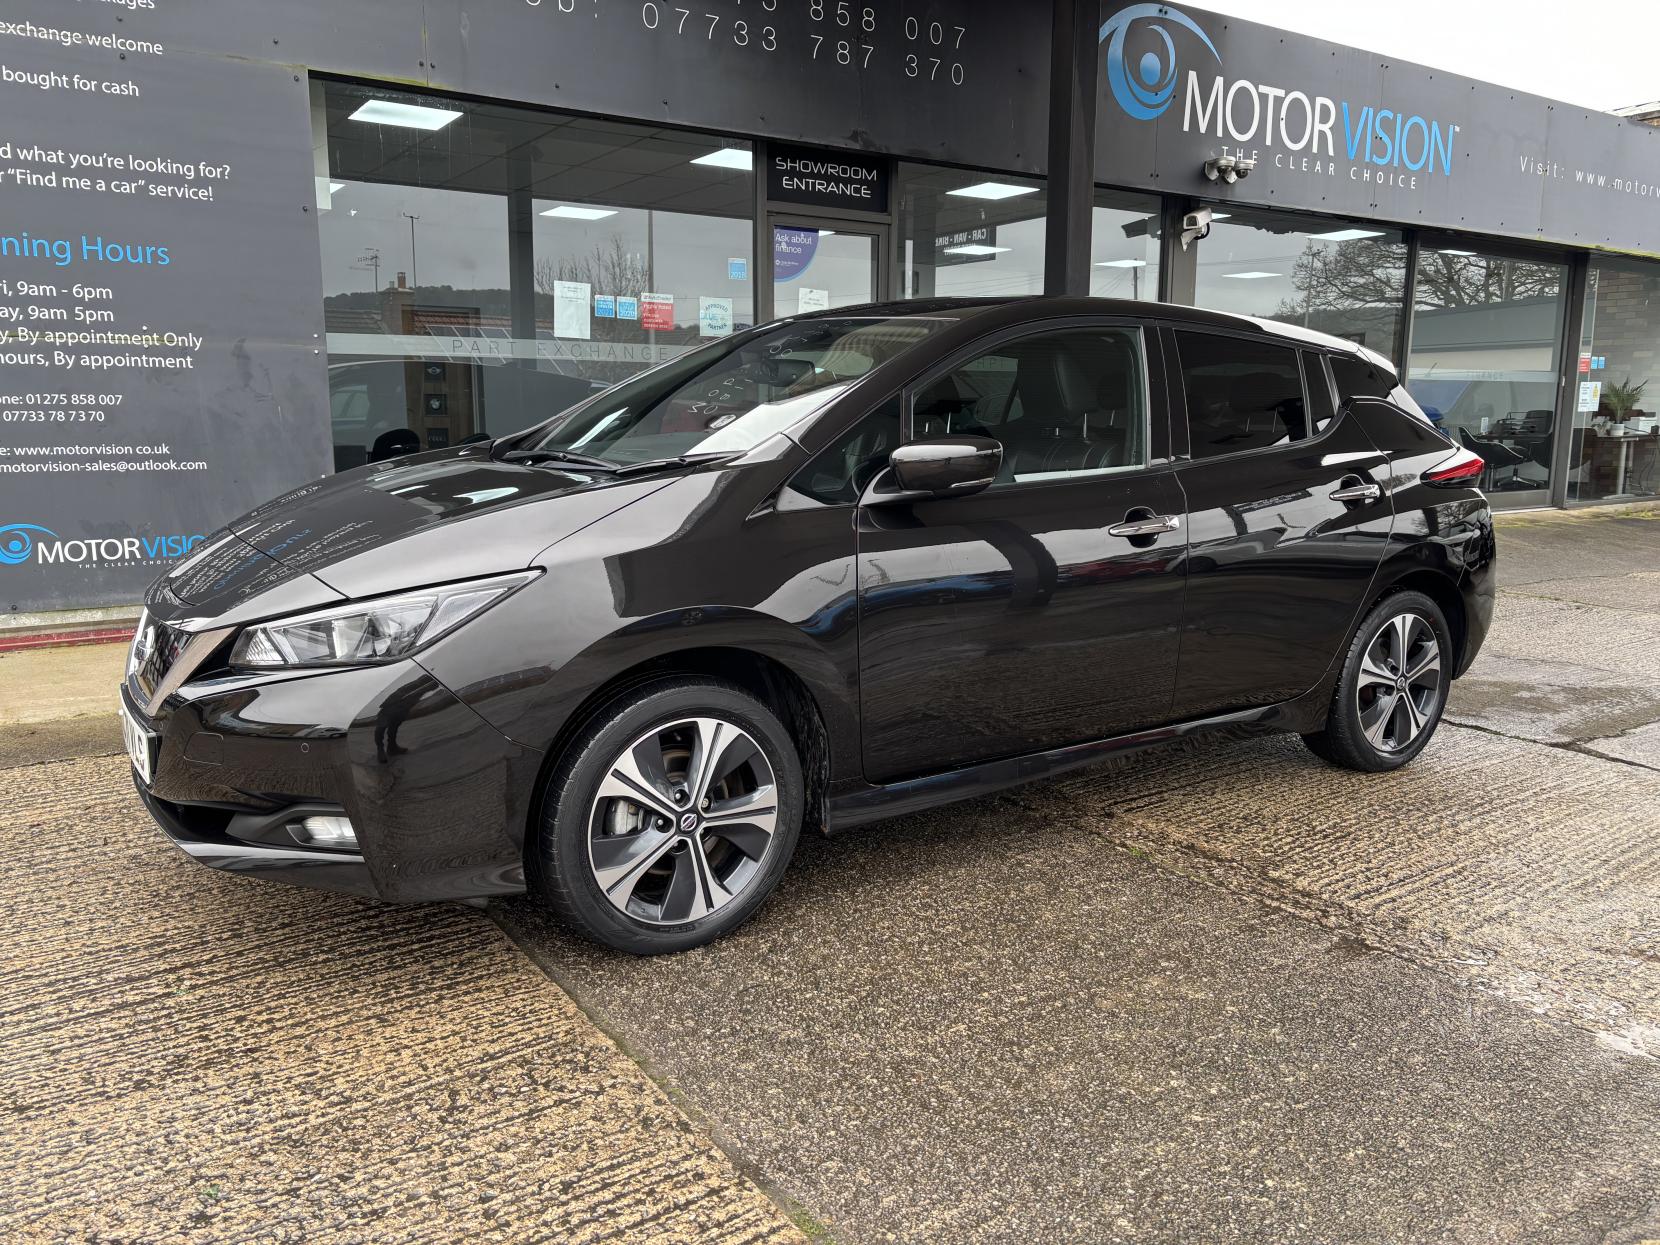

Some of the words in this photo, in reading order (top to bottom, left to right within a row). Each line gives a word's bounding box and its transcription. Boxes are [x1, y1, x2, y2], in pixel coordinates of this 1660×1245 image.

[809, 0, 876, 32] 858
[905, 16, 966, 49] 007
[0, 20, 82, 46] exchange
[86, 33, 164, 55] welcome
[641, 2, 777, 51] 07733
[810, 34, 875, 69] 787
[905, 54, 964, 86] 370
[2, 65, 70, 89] bought
[73, 74, 97, 92] for
[102, 81, 140, 97] cash
[17, 145, 65, 164] what
[69, 152, 125, 169] you’re
[129, 154, 195, 180] looking
[199, 162, 231, 180] for?
[775, 157, 877, 181] SHOWROOM
[1275, 153, 1335, 176] CLEAR
[1350, 167, 1417, 190] CHOICE
[1520, 155, 1565, 179] Visit:
[62, 176, 91, 190] me
[96, 179, 106, 191] a
[148, 183, 214, 201] service!
[782, 176, 872, 198] ENTRANCE
[81, 236, 170, 265] Hours
[775, 233, 789, 243] Ask
[791, 234, 812, 245] about
[775, 243, 802, 254] finance
[17, 281, 57, 297] 9am
[72, 283, 113, 301] 6pm
[27, 305, 67, 321] 9am
[74, 306, 114, 324] 5pm
[18, 327, 39, 345] By
[44, 329, 159, 347] appointment
[164, 331, 203, 351] Only
[54, 351, 75, 369] By
[80, 352, 193, 370] appointment
[537, 342, 668, 361] EXCHANGE
[0, 395, 23, 405] ne:
[25, 394, 67, 405] 01275
[71, 394, 96, 405] 858
[98, 394, 123, 405] 007
[3, 410, 45, 422] 07733
[0, 459, 208, 473] motorvision-sales@outlook.com
